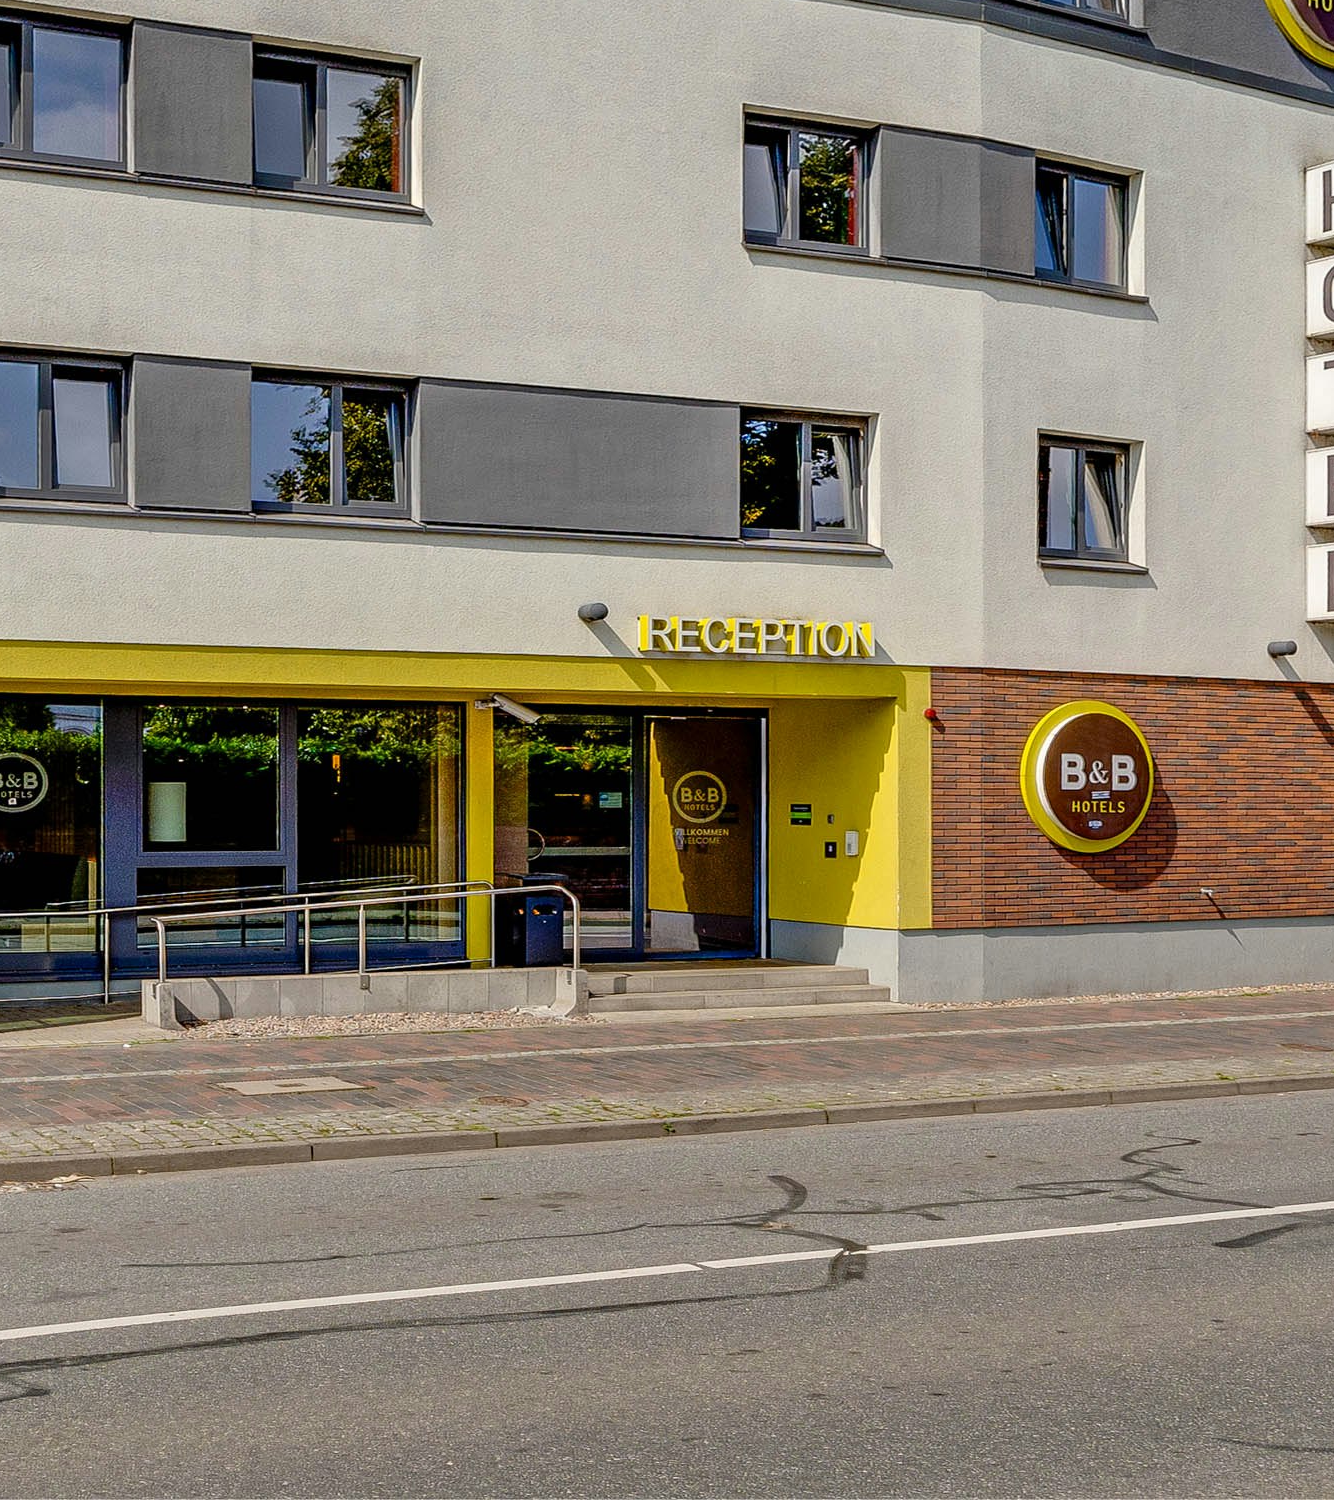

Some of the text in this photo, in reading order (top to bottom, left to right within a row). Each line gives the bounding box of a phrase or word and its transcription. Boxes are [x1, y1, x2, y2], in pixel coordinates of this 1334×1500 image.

[640, 615, 876, 657] RECEPTION
[1060, 752, 1138, 791] B&B
[680, 787, 720, 803] B&B
[683, 803, 716, 811] HOTELS
[1071, 800, 1126, 813] HOTELS
